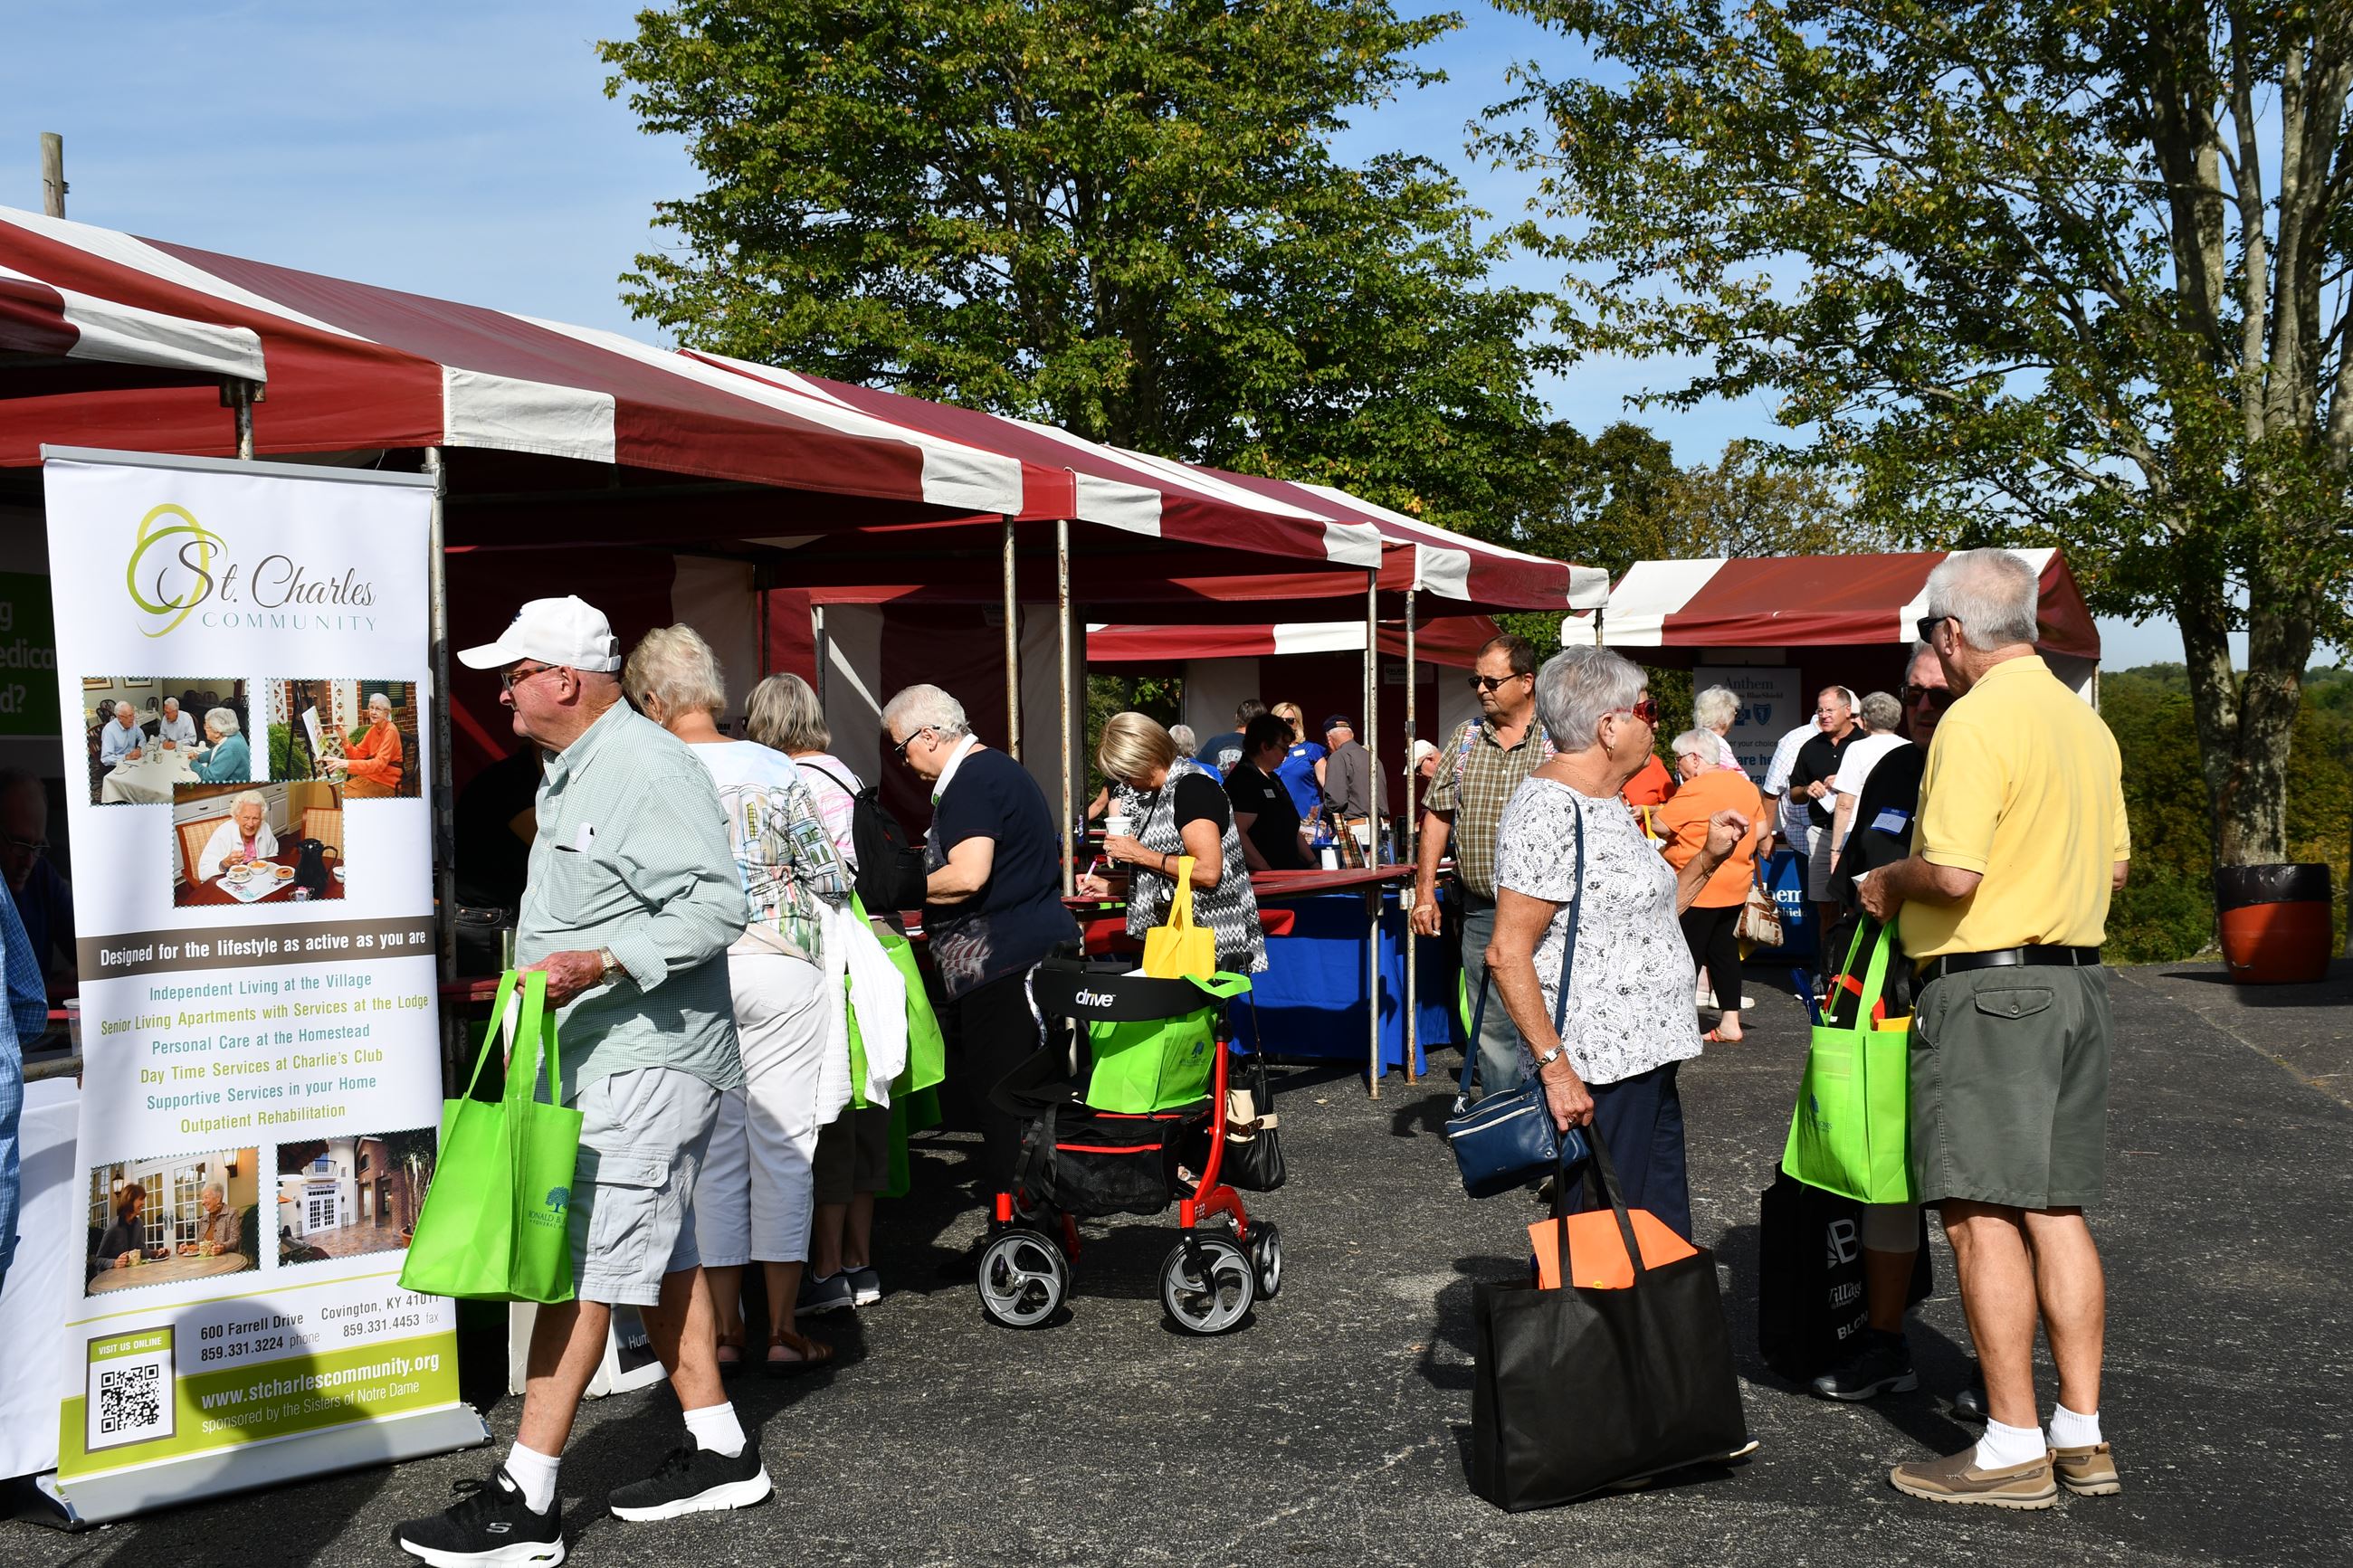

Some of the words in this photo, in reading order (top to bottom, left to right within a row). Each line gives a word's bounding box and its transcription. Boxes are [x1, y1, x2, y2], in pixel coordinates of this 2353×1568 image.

[157, 541, 238, 610] St.
[252, 555, 376, 609] Charles
[202, 612, 376, 632] COMMUNITY
[1724, 677, 1774, 689] Anthem
[100, 945, 152, 966] Designed
[158, 943, 178, 960] for
[185, 941, 210, 958] the
[217, 937, 278, 957] lifestyle
[283, 938, 300, 953] as
[306, 934, 349, 950] active
[356, 935, 373, 948] as
[379, 932, 404, 949] you
[408, 930, 426, 945] are
[150, 983, 233, 1001] Independent
[239, 979, 278, 996] Living
[284, 978, 295, 992] at
[300, 976, 319, 990] the
[326, 974, 372, 990] Village
[1075, 988, 1114, 1007] drive
[100, 1018, 131, 1036] Senior
[135, 1013, 171, 1030] Living
[178, 1007, 256, 1027] Apartments
[262, 1004, 288, 1020] with
[294, 1000, 348, 1017] Services
[354, 1000, 366, 1012] at
[373, 997, 392, 1011] the
[397, 994, 429, 1010] Lodge
[152, 1036, 212, 1055] Personal
[219, 1034, 250, 1050] Care
[256, 1033, 269, 1047] at
[274, 1030, 293, 1045] the
[299, 1023, 370, 1042] Homestead
[140, 1069, 165, 1084] Day
[171, 1065, 205, 1080] Time
[213, 1059, 270, 1077] Services
[276, 1057, 288, 1070] at
[293, 1051, 348, 1069] Charlie's
[354, 1048, 383, 1063] Club
[147, 1091, 221, 1112] Supportive
[227, 1083, 283, 1102] Services
[290, 1082, 300, 1096] in
[306, 1079, 333, 1097] your
[339, 1075, 376, 1091] Home
[181, 1113, 252, 1135] Outpatient
[258, 1105, 346, 1126] Rehabilitation
[321, 1300, 382, 1321] Covington,
[386, 1296, 402, 1309] KY
[201, 1325, 224, 1340] 600
[228, 1318, 268, 1336] Farrell
[273, 1314, 304, 1328] Drive
[343, 1314, 420, 1337] 859.331.4453
[425, 1312, 439, 1324] fax
[99, 1344, 118, 1354] VISIT
[120, 1342, 131, 1351] US
[133, 1337, 162, 1349] ONLINE
[201, 1335, 284, 1362] 859.331.3224
[290, 1331, 320, 1349] phone
[202, 1354, 440, 1410] www.stcharlescommunity.org
[202, 1410, 262, 1434] sponsored
[266, 1406, 280, 1422] by
[282, 1402, 300, 1417] the
[304, 1395, 341, 1413] Sisters
[344, 1391, 355, 1404] of
[357, 1385, 386, 1403] Notre
[389, 1381, 420, 1398] Dame
